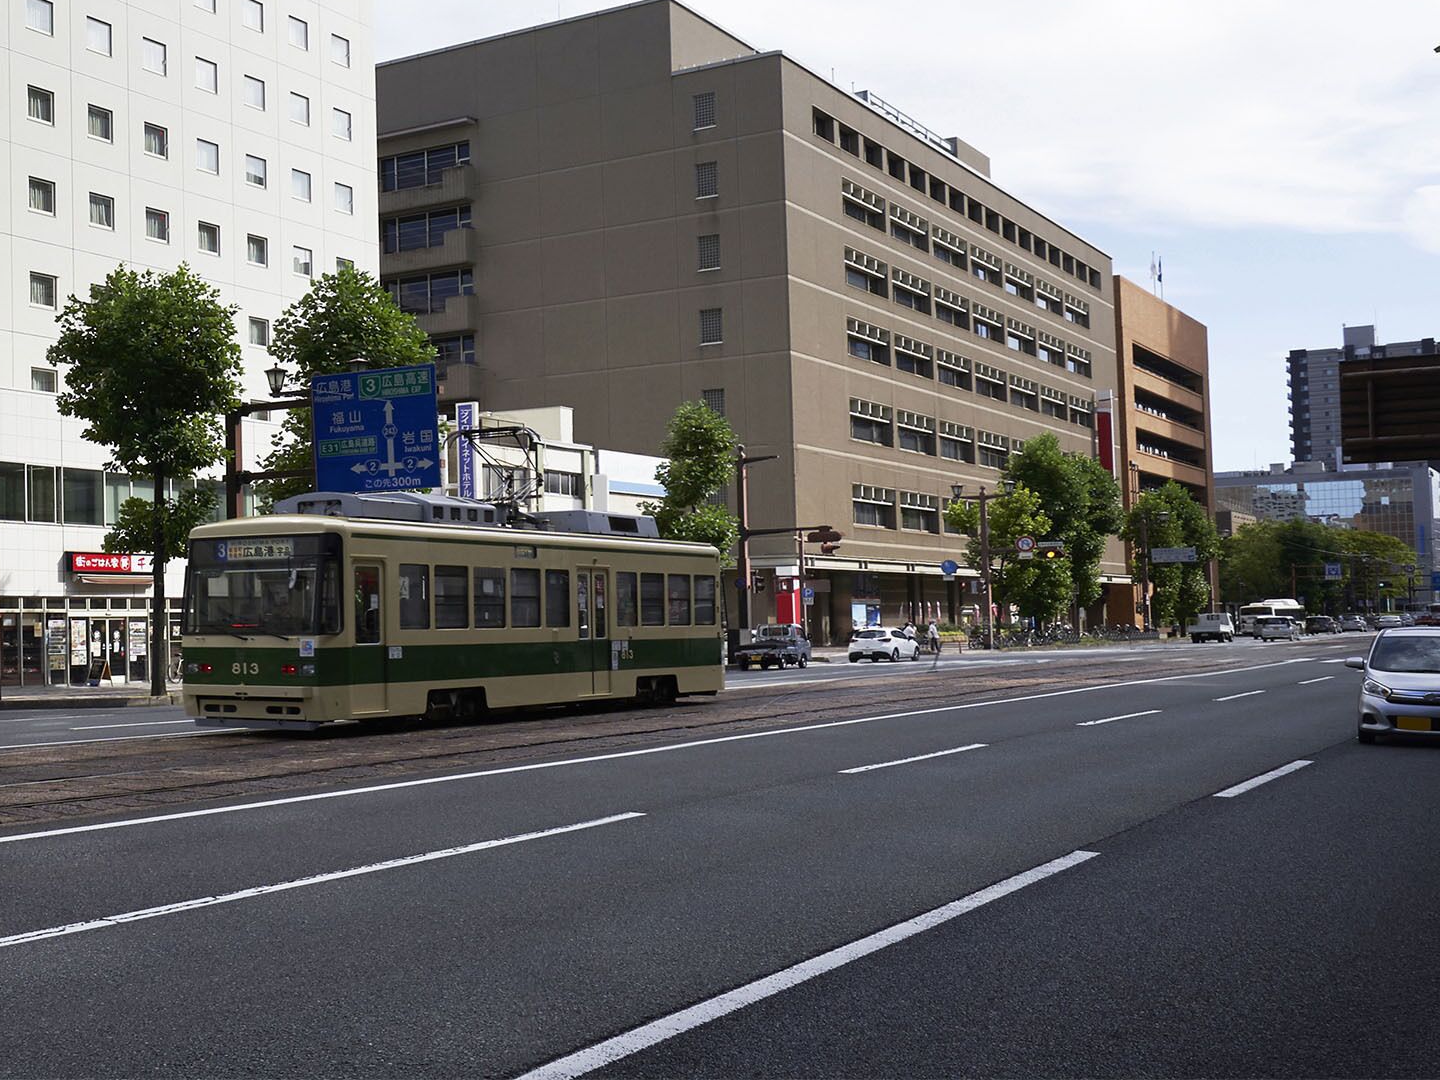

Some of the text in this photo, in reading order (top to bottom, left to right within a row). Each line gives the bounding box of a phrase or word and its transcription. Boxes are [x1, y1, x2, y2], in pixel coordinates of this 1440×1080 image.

[381, 369, 429, 388] 広島高速
[316, 379, 352, 394] 広島港
[366, 379, 377, 392] 3
[332, 409, 362, 424] 福山
[329, 425, 365, 433] Fukuyama
[402, 430, 433, 445] 岩国
[321, 444, 339, 453] E31
[404, 444, 433, 453] Iwakuni
[369, 462, 377, 471] 2
[407, 459, 414, 468] 2
[365, 476, 422, 489] この先300m
[217, 543, 226, 558] 3
[243, 545, 274, 557] 広島港
[231, 662, 259, 674] 813
